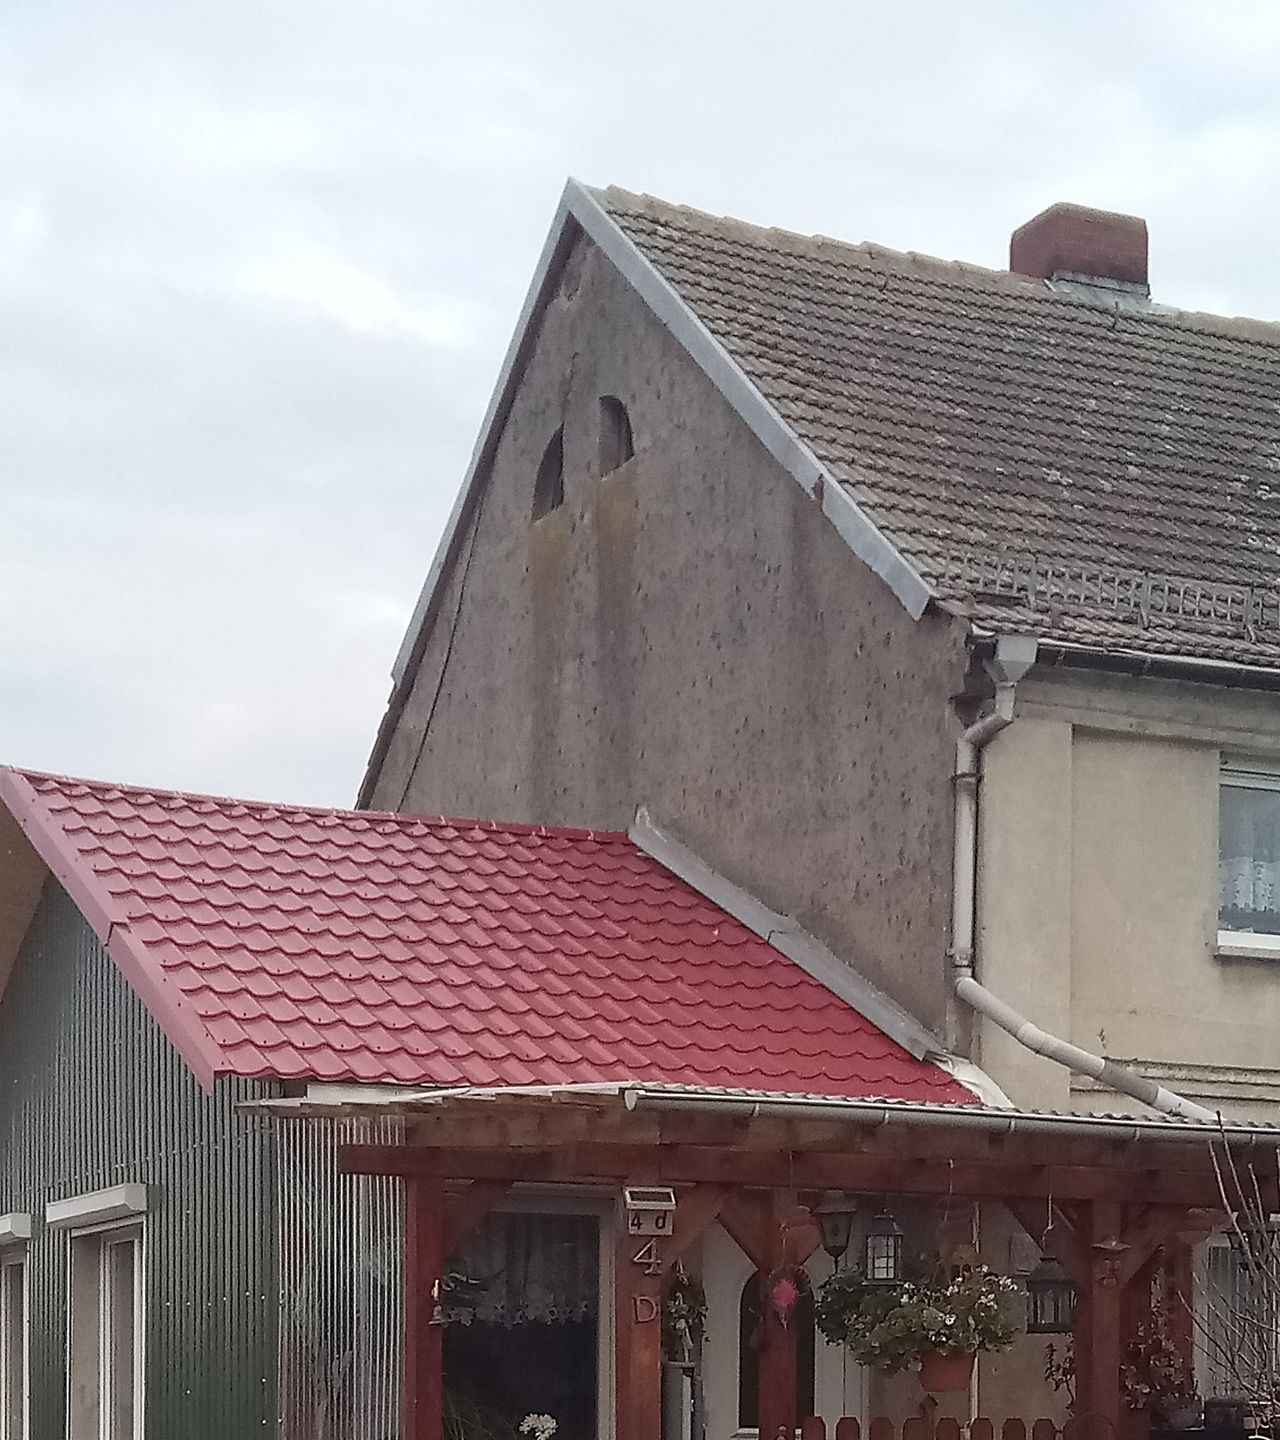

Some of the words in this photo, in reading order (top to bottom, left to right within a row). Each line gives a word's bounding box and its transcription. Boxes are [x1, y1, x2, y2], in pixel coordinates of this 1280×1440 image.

[630, 1213, 643, 1230] 4
[655, 1211, 667, 1230] d
[632, 1237, 662, 1275] 4
[632, 1296, 659, 1324] D
